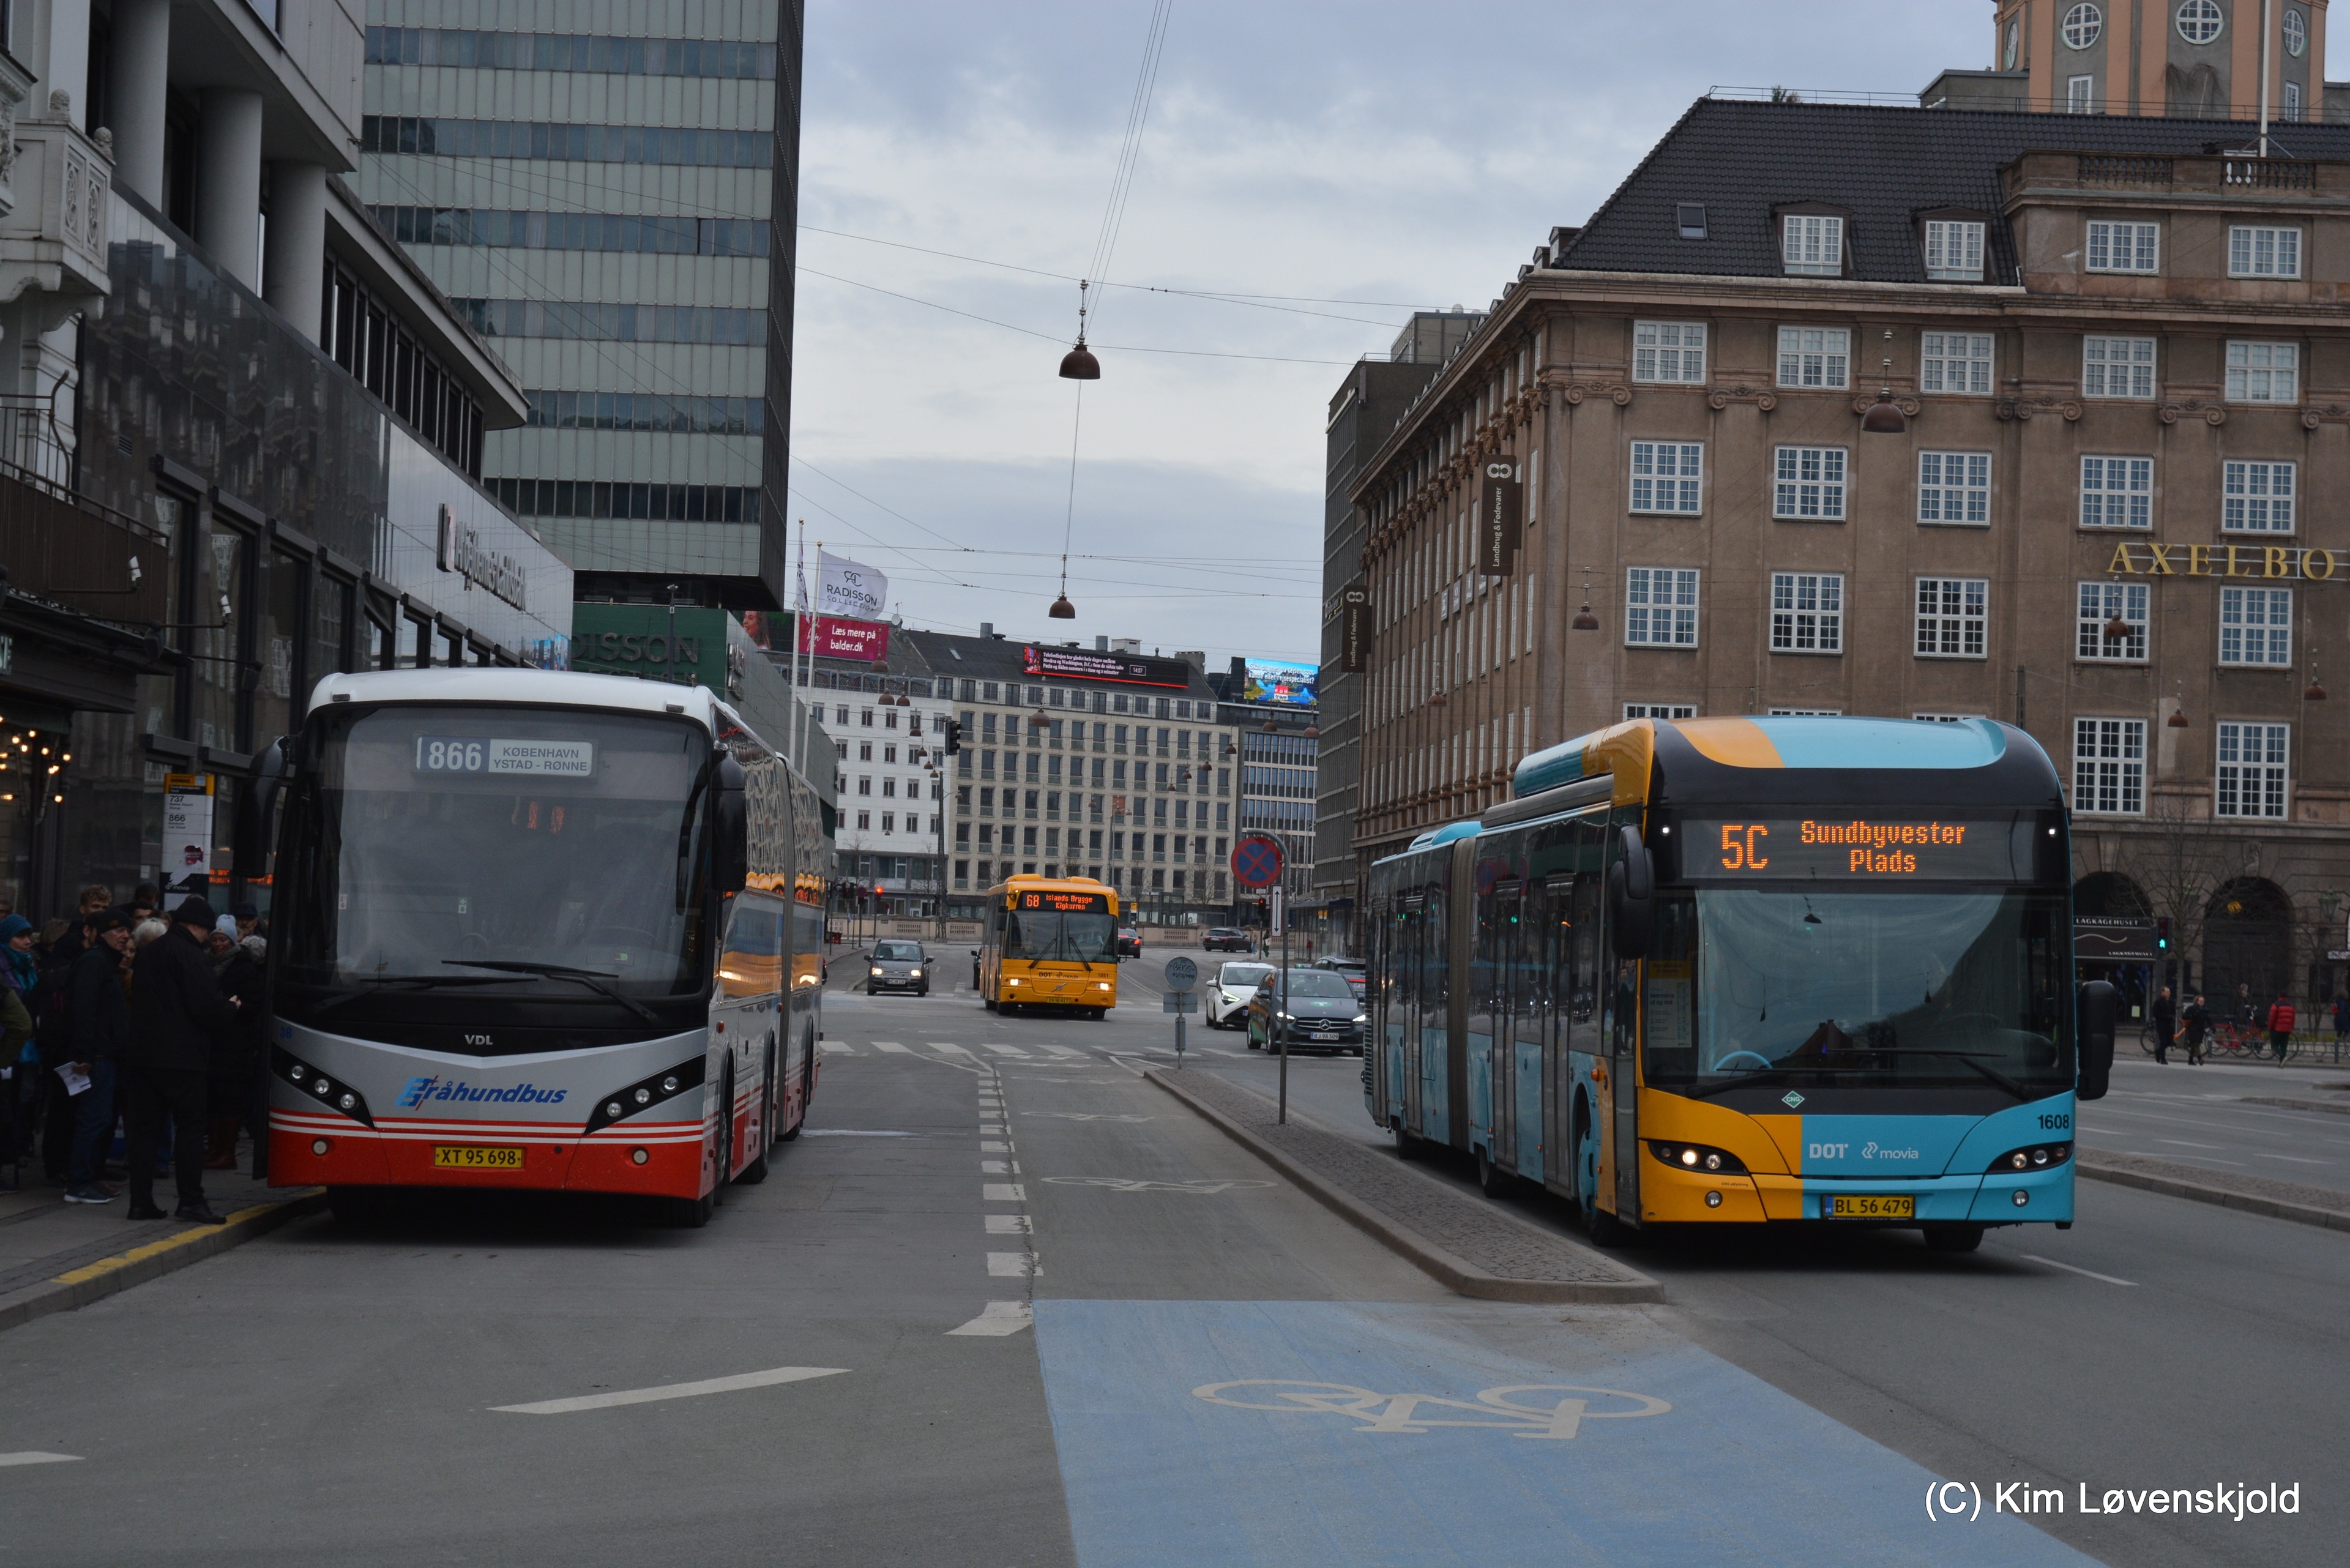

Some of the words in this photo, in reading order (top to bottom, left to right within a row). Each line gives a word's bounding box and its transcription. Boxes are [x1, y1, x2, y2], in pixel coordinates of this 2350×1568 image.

[1492, 532, 1502, 567] Landbrug
[2105, 542, 2350, 581] AXELBO
[827, 584, 878, 607] RADISSON
[832, 624, 846, 636] Læs
[847, 629, 865, 638] mere
[867, 630, 876, 641] på
[830, 639, 864, 652] balder.dk
[428, 741, 482, 771] 866
[503, 747, 579, 758] KØBENHAVN
[494, 759, 532, 769] YSTAD
[544, 761, 587, 771] RØNNE
[1801, 820, 1966, 848] Sundbyvester
[1721, 825, 1768, 869] 5C
[1850, 849, 1916, 872] Plads
[1026, 894, 1040, 908] 68
[1056, 902, 1086, 911] Kigkurren
[1070, 895, 1093, 905] Brygge
[280, 1027, 292, 1039] 38
[465, 1034, 493, 1045] VDL
[2037, 1114, 2070, 1129] 1608
[441, 1150, 463, 1163] XT
[466, 1151, 484, 1164] 95
[488, 1151, 517, 1165] 698
[1809, 1143, 1849, 1159] DOT
[1879, 1147, 1919, 1159] movia
[1836, 1199, 1854, 1214] BL
[1860, 1199, 1878, 1214] 56
[1882, 1199, 1911, 1214] 479
